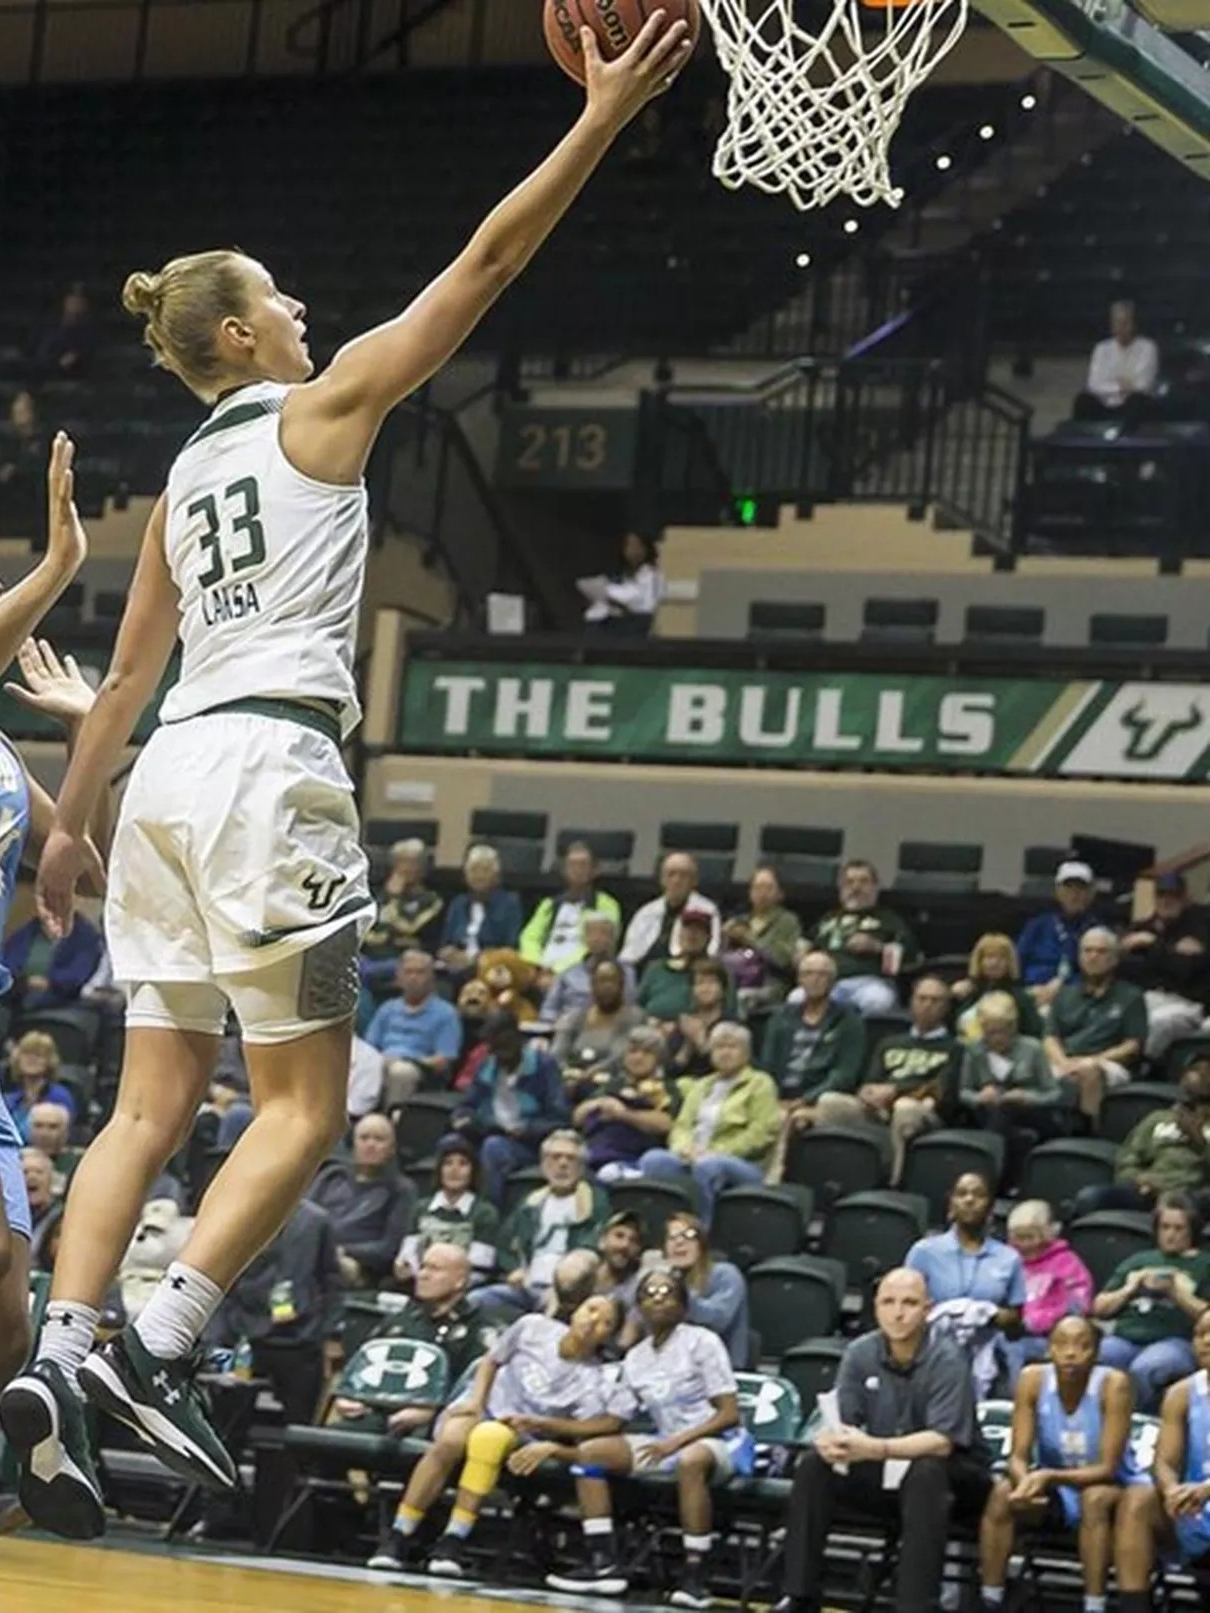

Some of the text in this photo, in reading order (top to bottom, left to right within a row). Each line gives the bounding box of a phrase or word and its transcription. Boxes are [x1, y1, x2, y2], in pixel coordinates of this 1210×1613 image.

[518, 423, 606, 470] 213
[187, 475, 267, 589] 33
[433, 675, 995, 754] THE BULLS
